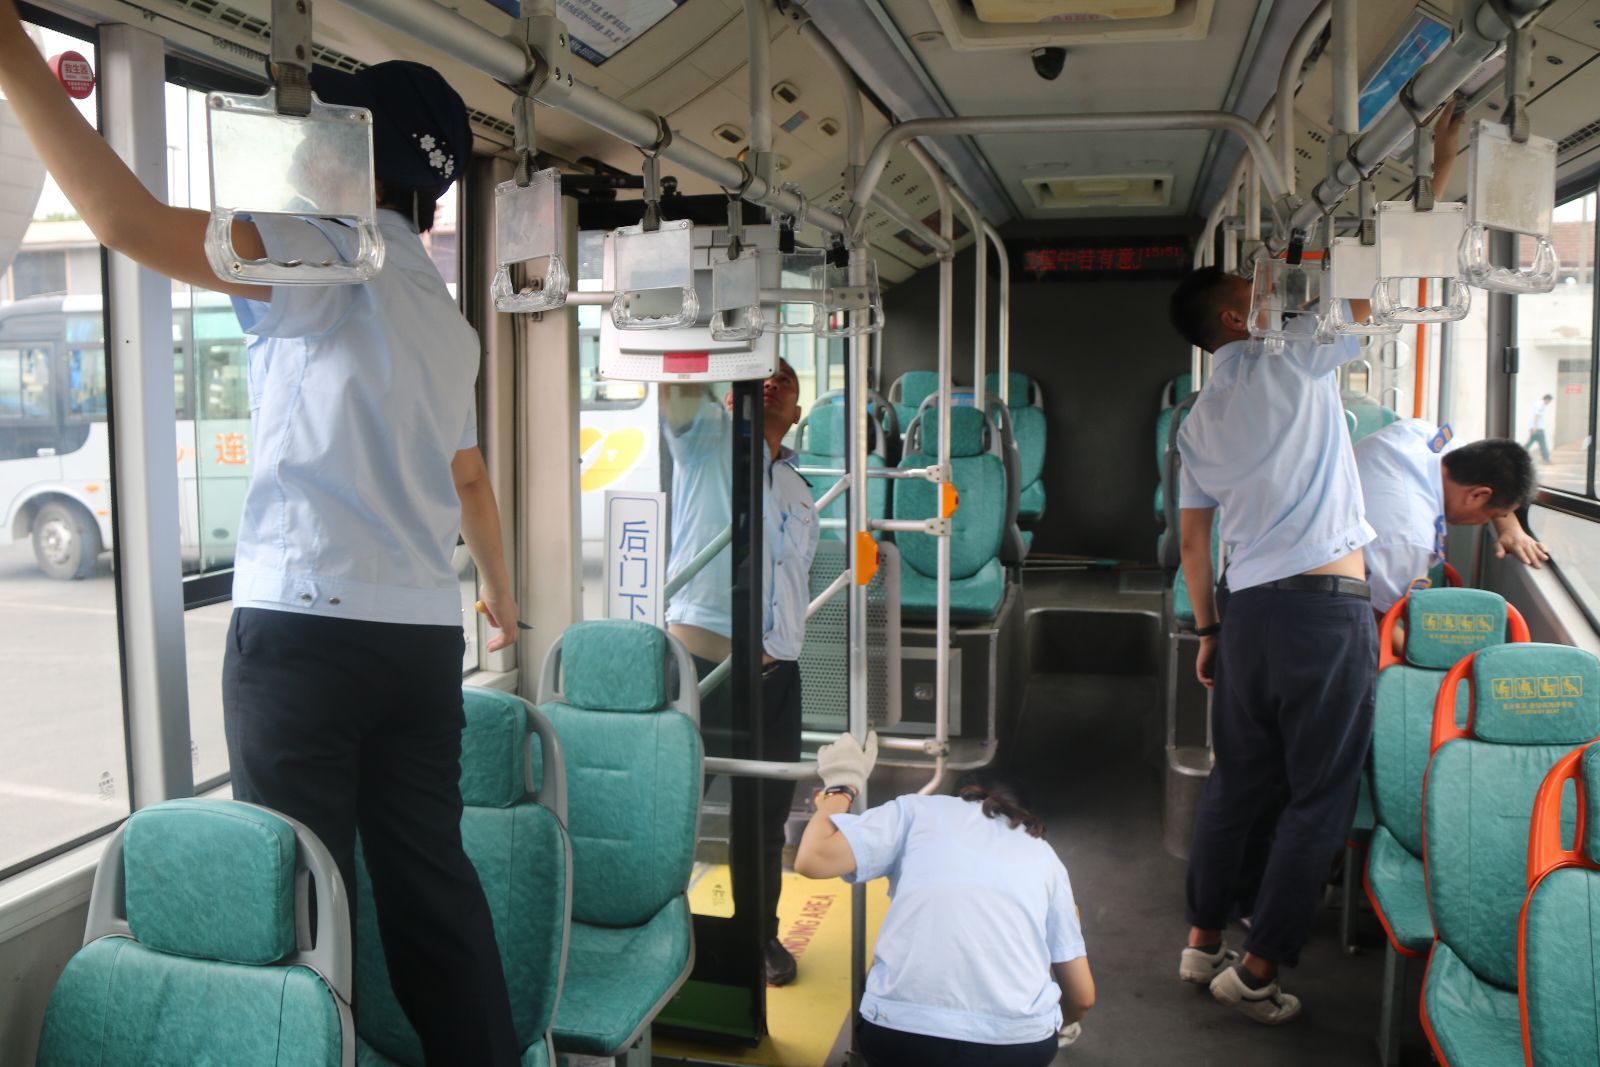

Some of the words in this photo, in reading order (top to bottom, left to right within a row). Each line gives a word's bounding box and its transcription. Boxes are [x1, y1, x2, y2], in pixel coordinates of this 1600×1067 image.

[216, 432, 247, 465] 连
[619, 520, 649, 620] 后门下
[799, 894, 837, 919] AREA
